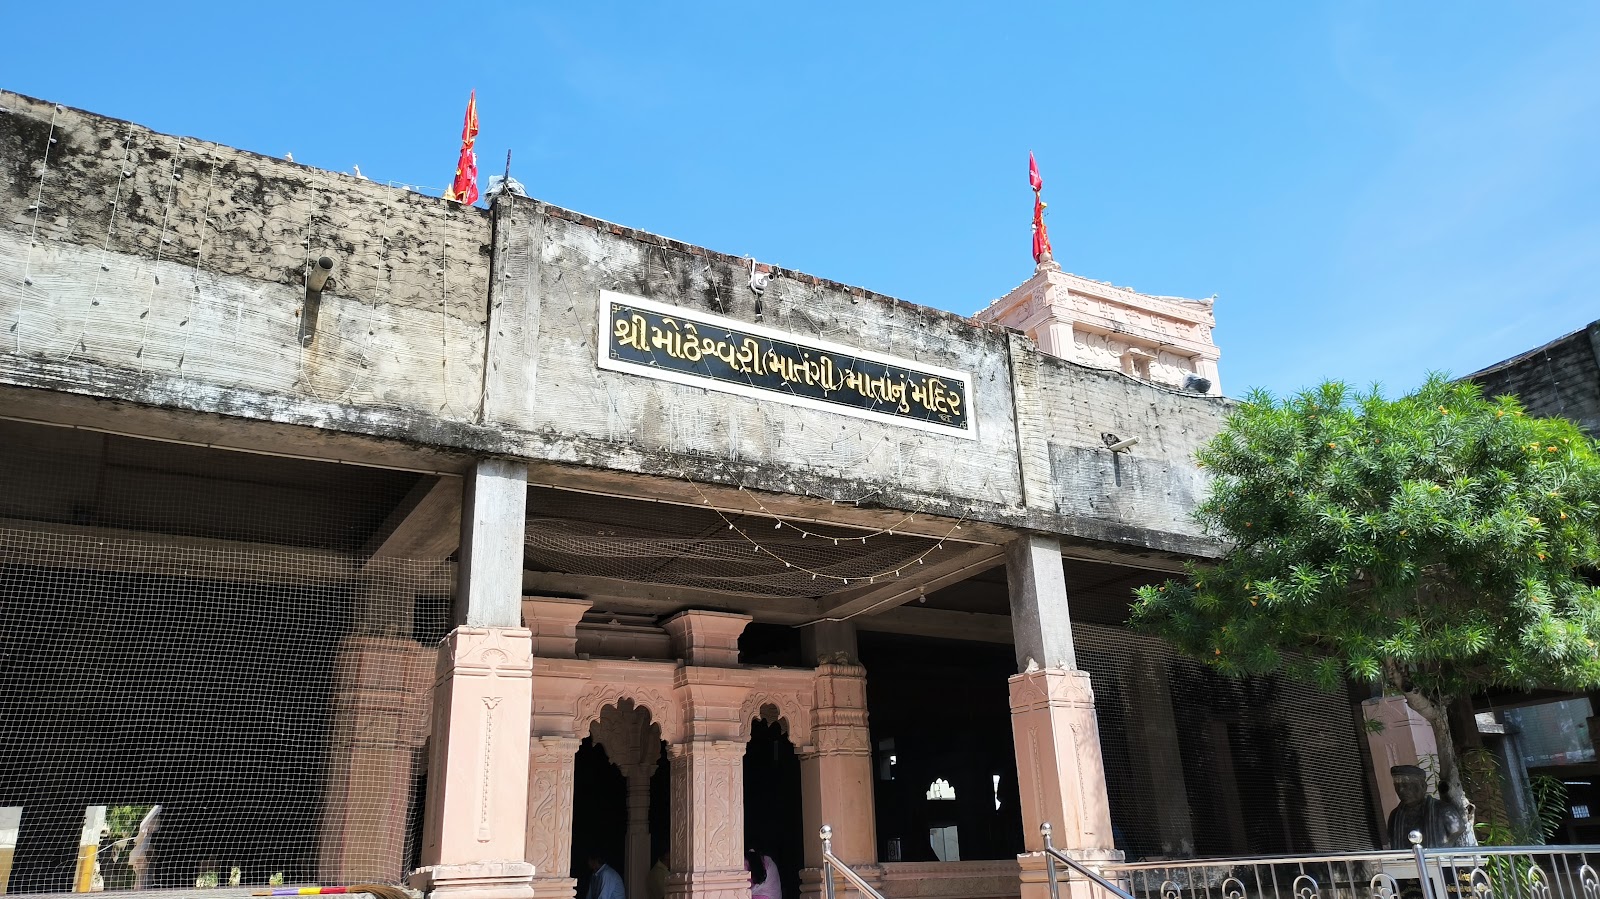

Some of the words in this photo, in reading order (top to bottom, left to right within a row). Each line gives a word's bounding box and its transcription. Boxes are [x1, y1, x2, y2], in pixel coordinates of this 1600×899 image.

[614, 314, 651, 352] શ્રી
[845, 368, 911, 413] માતાનું
[911, 378, 961, 416] મંદિર
